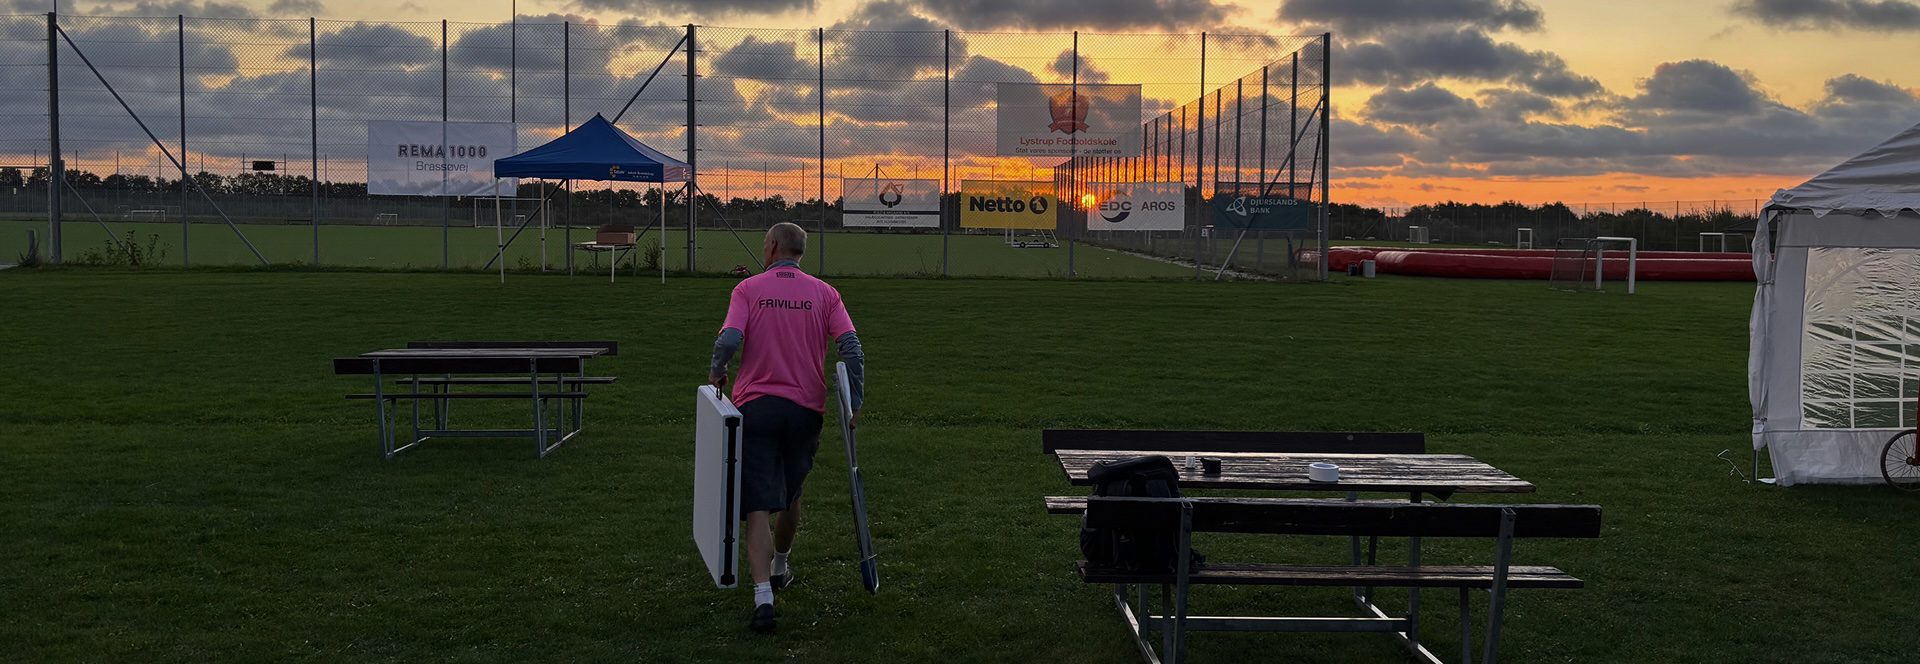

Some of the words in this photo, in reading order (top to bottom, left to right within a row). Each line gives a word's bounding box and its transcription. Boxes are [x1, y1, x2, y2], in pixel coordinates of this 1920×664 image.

[1020, 138, 1054, 147] Lystrup
[1056, 138, 1117, 146] Fodboldskole
[399, 145, 446, 158] REMA
[449, 146, 486, 158] 1000
[416, 160, 468, 173] Brassøvej
[969, 196, 1025, 212] Netto
[1099, 201, 1132, 211] EDC
[1141, 201, 1175, 211] AROS
[758, 299, 813, 310] FRIVILLIG
